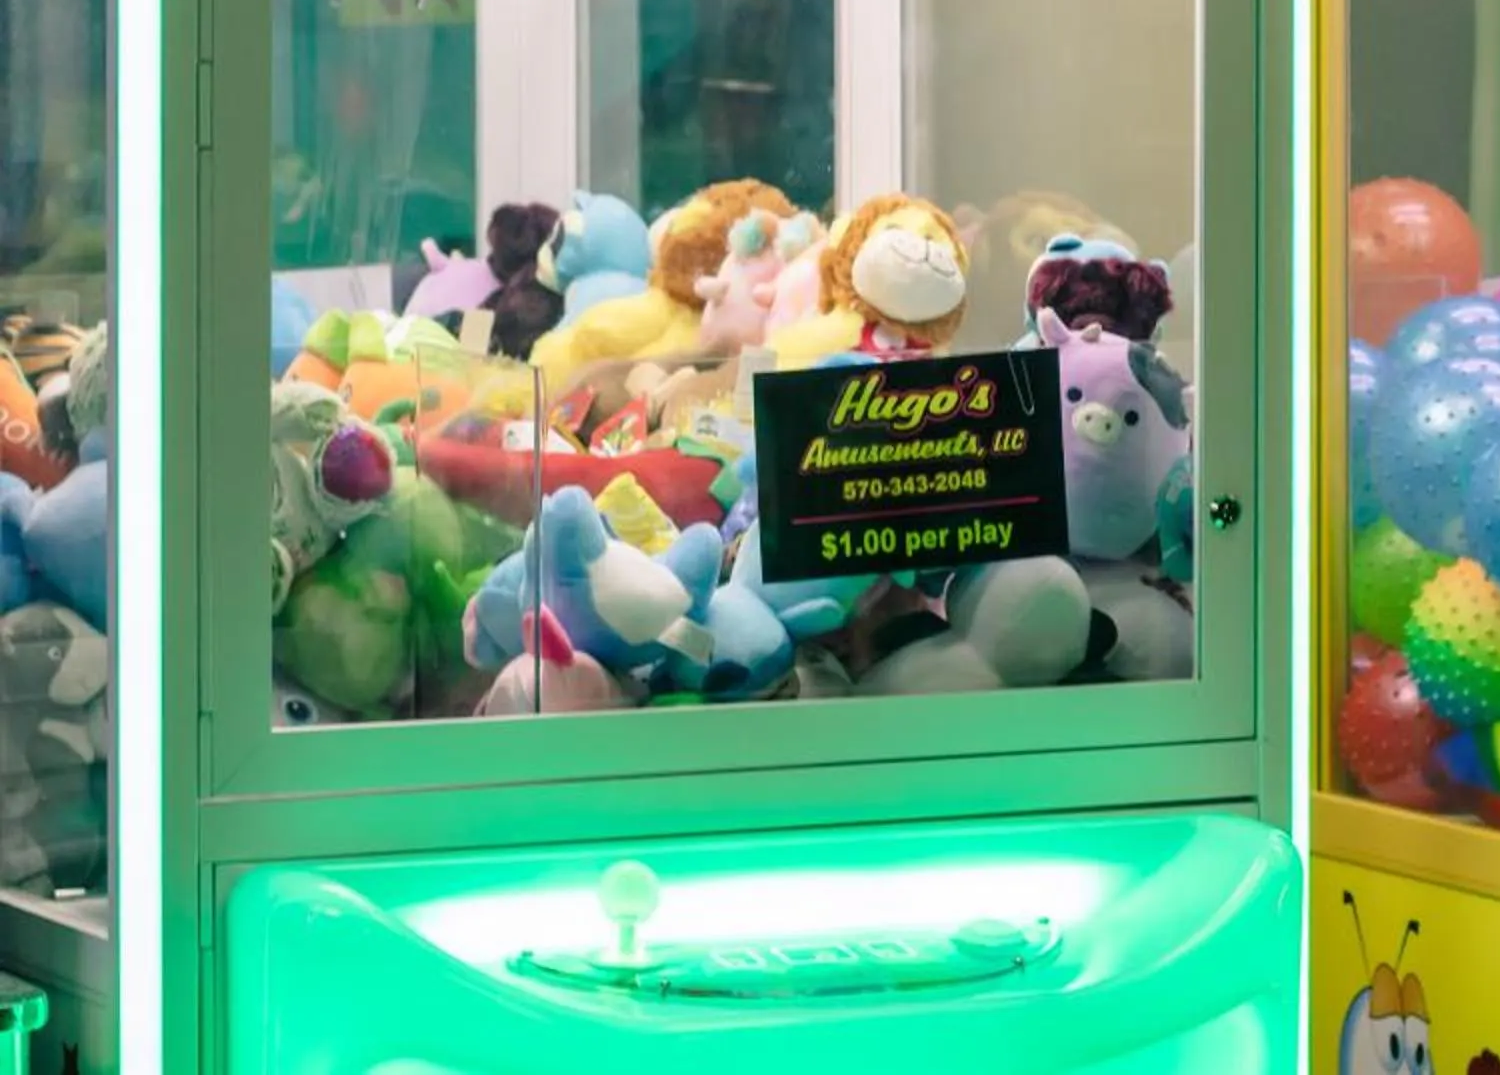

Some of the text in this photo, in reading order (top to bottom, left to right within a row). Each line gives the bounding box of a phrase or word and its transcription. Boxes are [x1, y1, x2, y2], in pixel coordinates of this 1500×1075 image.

[831, 367, 994, 431] Hugo's
[802, 430, 984, 471] Amusements,
[843, 469, 987, 500] 570-343-2048
[821, 519, 1013, 561] $1.00 per play
